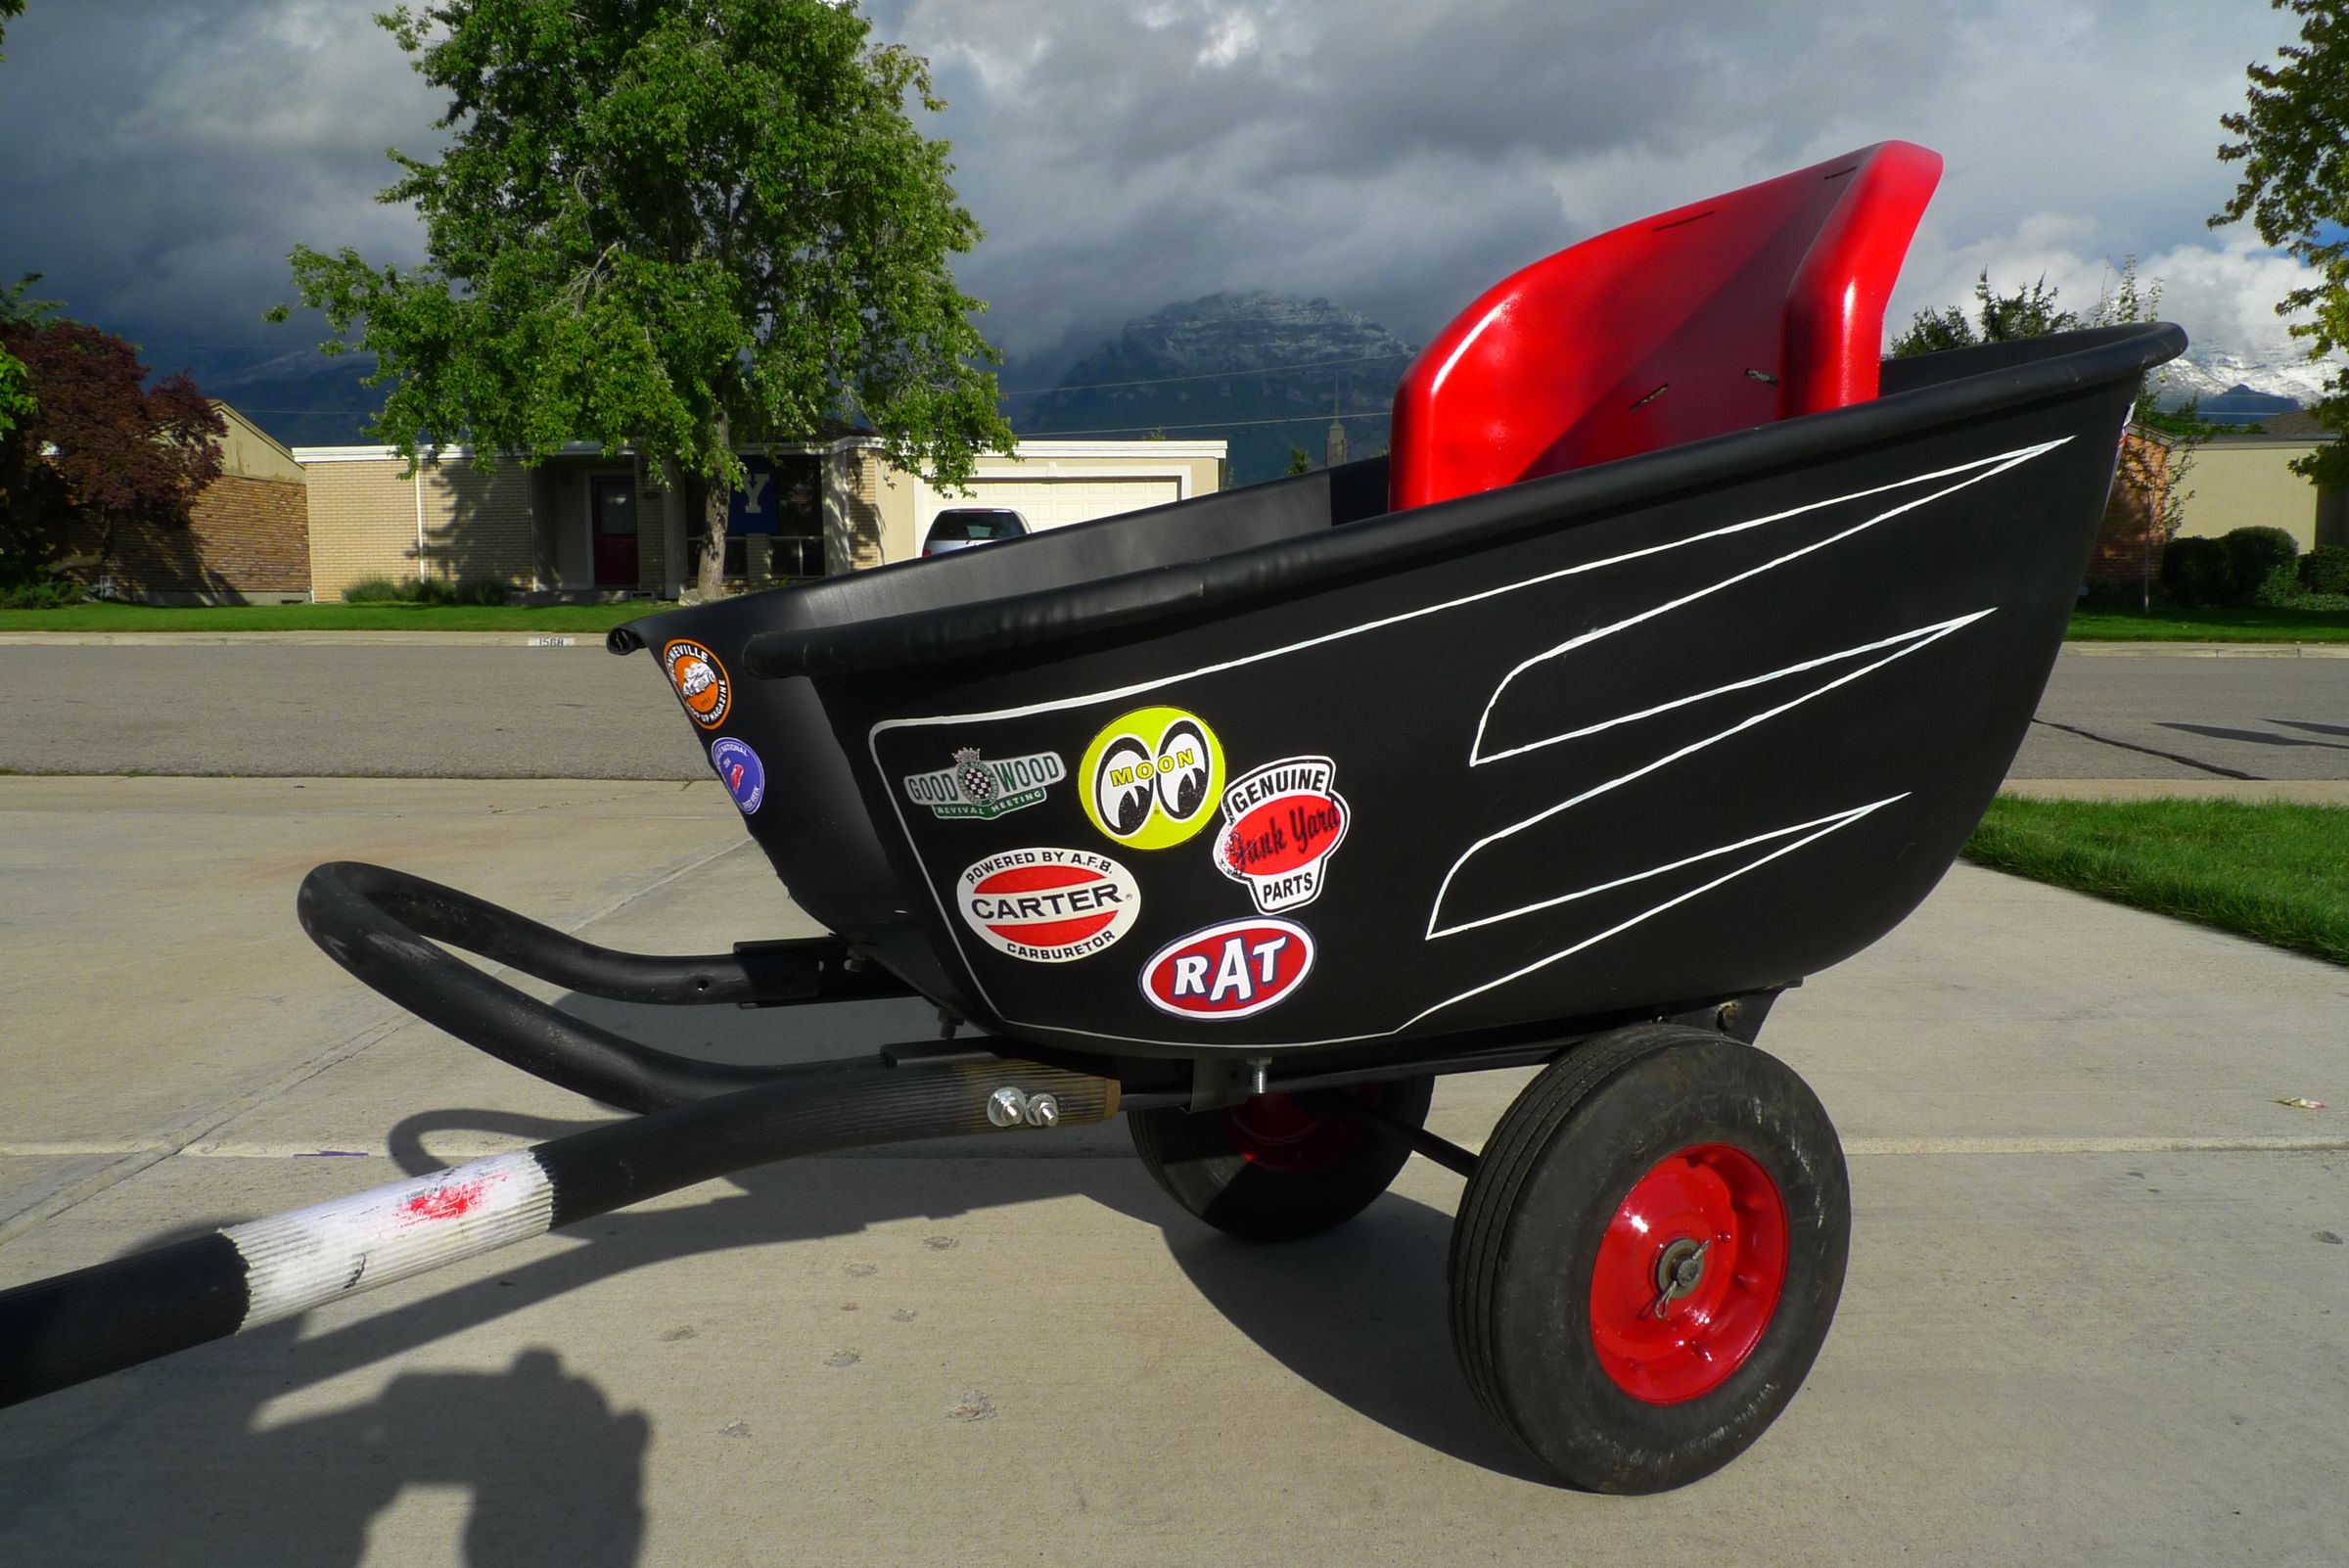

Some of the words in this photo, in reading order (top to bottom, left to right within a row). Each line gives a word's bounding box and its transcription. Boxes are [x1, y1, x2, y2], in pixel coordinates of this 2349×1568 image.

[743, 474, 770, 514] Y
[709, 679, 727, 721] MAGAZINE
[908, 773, 959, 802] GOOD
[992, 755, 1061, 793] WOOD
[1110, 748, 1195, 787] MOON
[937, 805, 985, 815] REVIVAL
[990, 790, 1042, 812] MEETING
[1231, 769, 1326, 812] GENUINE
[1229, 817, 1288, 877] Junk
[1288, 797, 1340, 853] Yard
[965, 852, 1036, 885] POWERED
[1041, 851, 1066, 862] BY
[1070, 853, 1113, 875] A.F.B.
[971, 883, 1124, 920] CARTER
[1263, 872, 1313, 904] PARTS
[1006, 930, 1116, 960] CARBURETOR
[1174, 935, 1288, 1002] RAT
